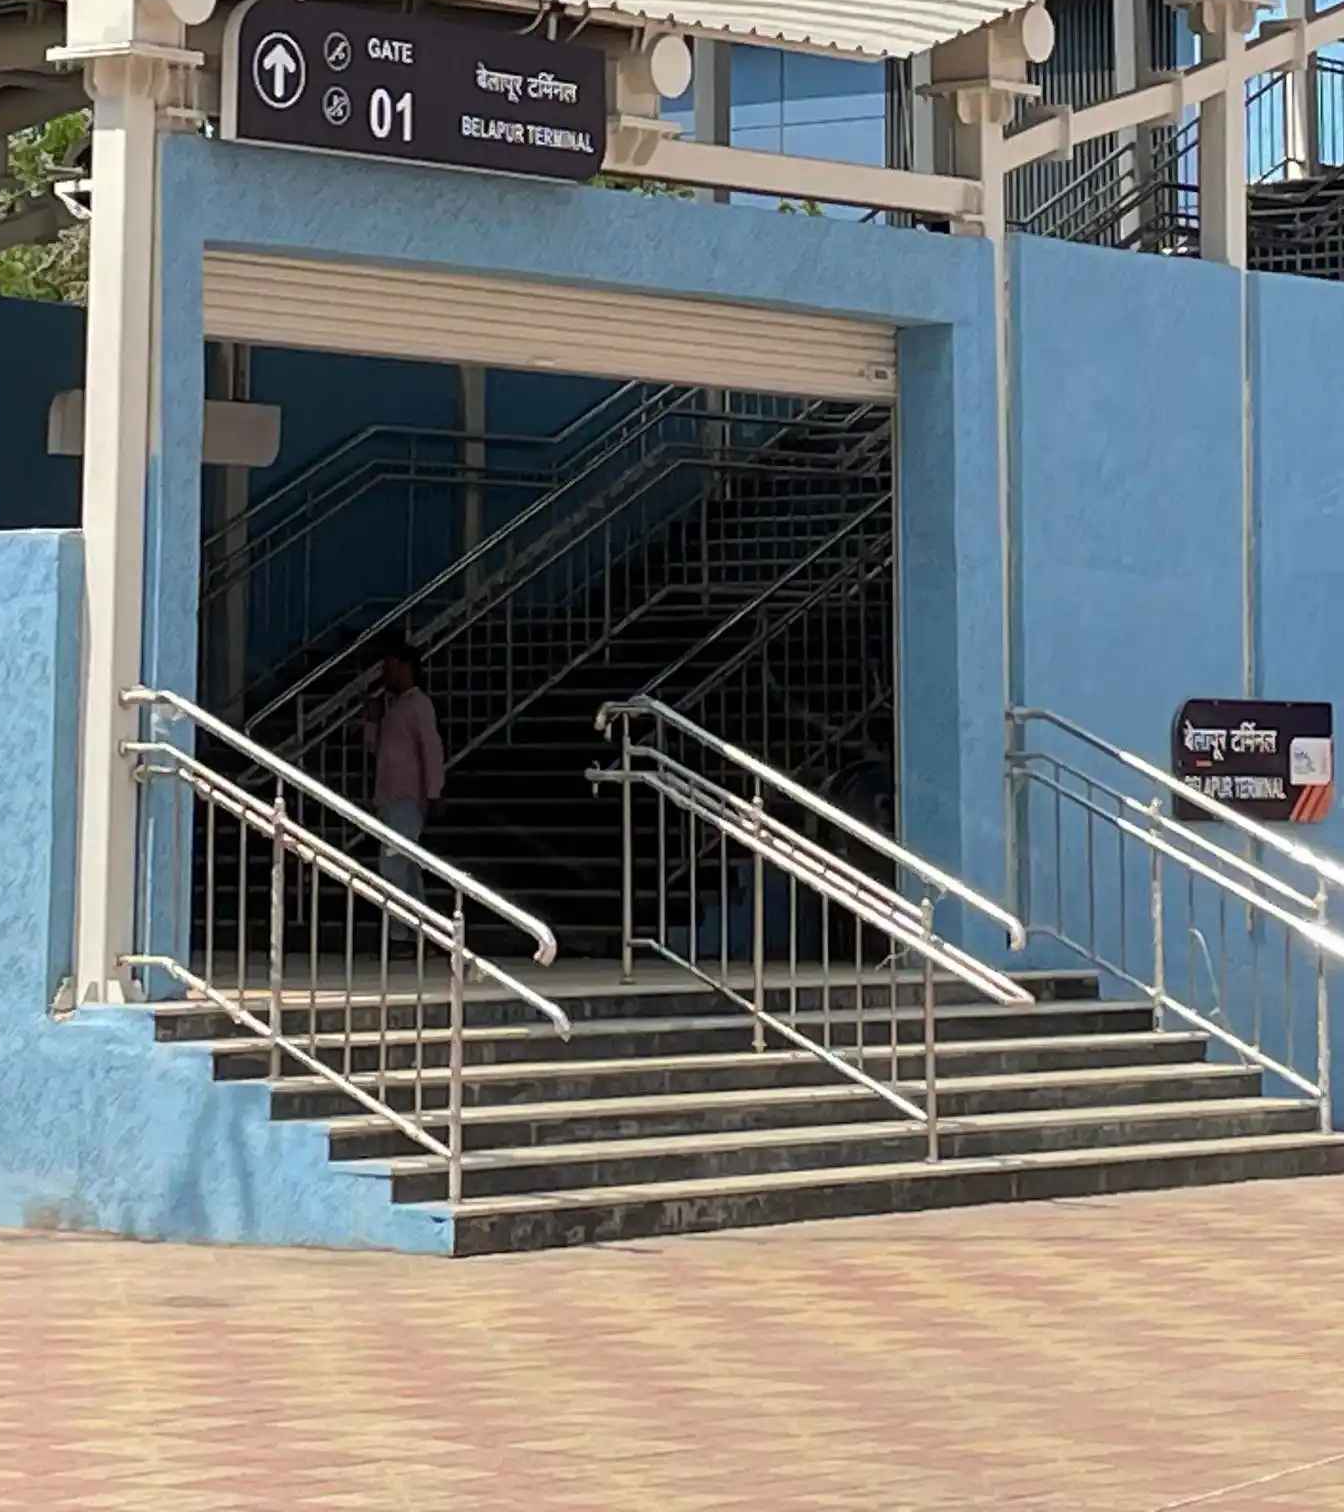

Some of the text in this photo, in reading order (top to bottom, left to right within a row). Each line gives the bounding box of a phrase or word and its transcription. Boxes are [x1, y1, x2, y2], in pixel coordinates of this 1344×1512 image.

[367, 37, 415, 65] GATE
[475, 60, 523, 104] बेलापूर
[368, 87, 414, 142] 01
[461, 114, 595, 153] BELAPUR TERMINAL
